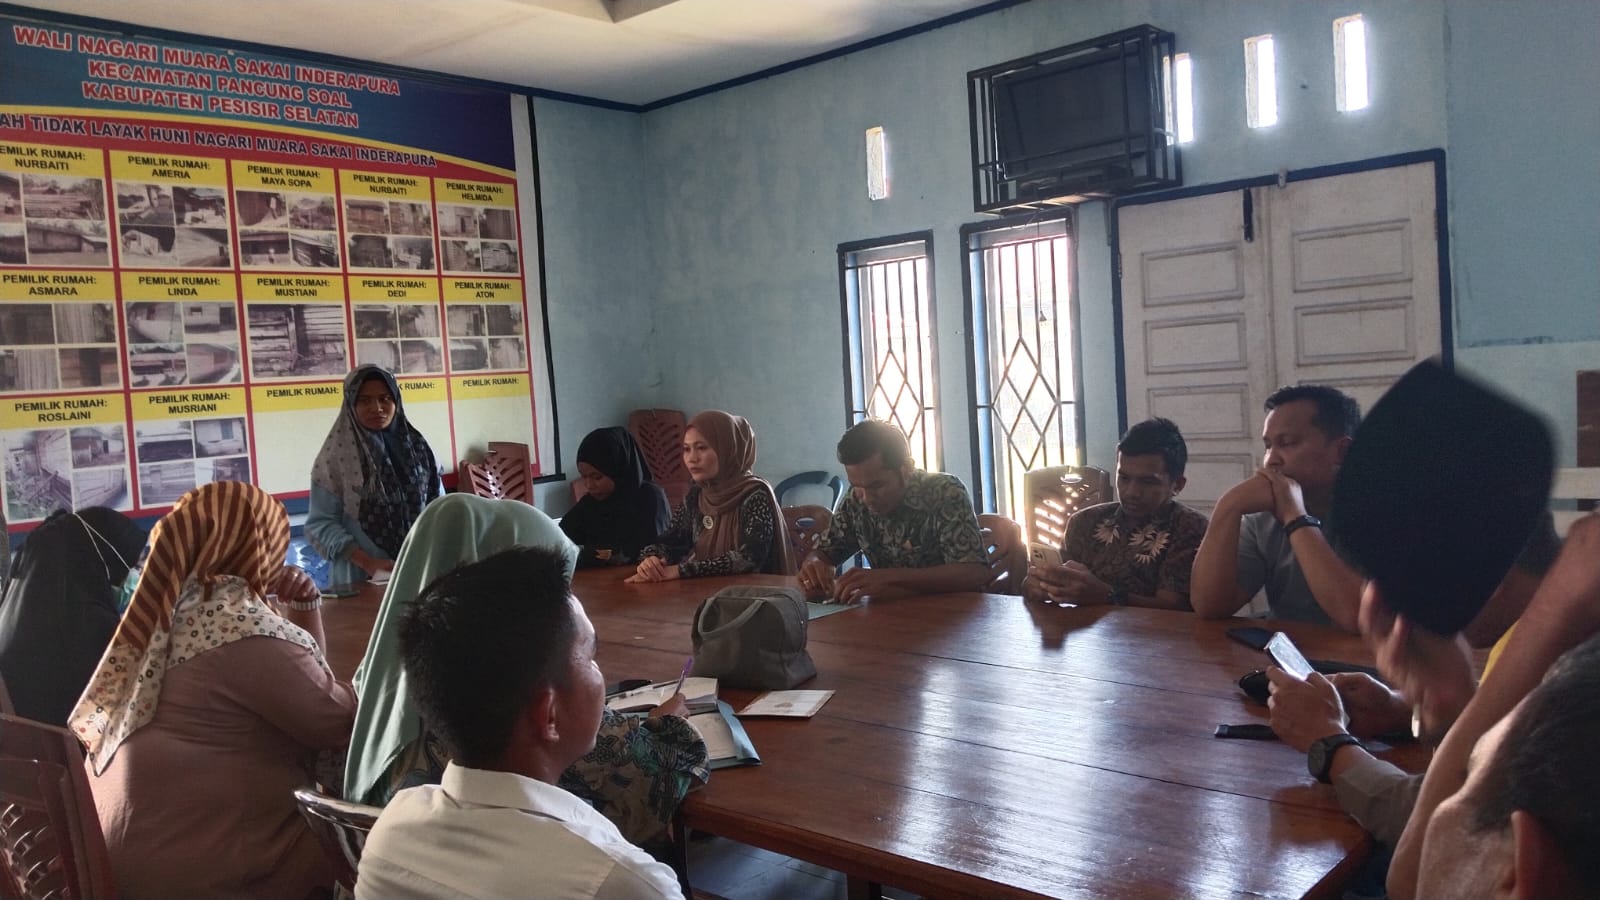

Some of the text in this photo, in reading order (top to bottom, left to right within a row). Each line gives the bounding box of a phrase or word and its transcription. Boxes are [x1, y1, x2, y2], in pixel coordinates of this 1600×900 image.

[13, 25, 400, 96] WALI NAGARI MUARA SAKAI INDERAPURA
[88, 59, 352, 109] KECAMATAN PANCUNG SOAL
[82, 81, 358, 128] KABUPATEN PESISIR SELATAN
[30, 115, 86, 135] TIDAK
[90, 122, 145, 141] LAYAK
[150, 128, 190, 145] HUNI
[194, 133, 252, 150] NAGARI
[256, 138, 308, 155] MUARA
[311, 142, 352, 160] SAKAI
[356, 147, 437, 167] INDERAPURA
[41, 148, 86, 161] RUMAH:
[15, 158, 70, 171] NURBAITI
[128, 155, 210, 170] PEMILIK RUMAH:
[151, 168, 191, 179] AMERIA
[247, 165, 320, 178] PEMILIK RUMAH:
[261, 177, 312, 188] MAYA SOPA
[353, 174, 418, 187] PEMILIK RUMAH:
[370, 185, 407, 196] NURBAITI
[446, 182, 504, 194] PEMILIK RUMAH:
[461, 192, 493, 203] HELMIDA
[3, 274, 97, 285] PEMILIK RUMAH:
[138, 276, 220, 286] PEMILIK RUMAH:
[257, 278, 330, 288] PEMILIK RUMAH:
[362, 280, 427, 289] PEMILIK RUMAH:
[454, 281, 511, 290] PEMILIK RUMAH:
[28, 286, 78, 297] ASMARA
[167, 287, 198, 297] LINDA
[275, 288, 317, 298] MUSTIANI
[388, 289, 406, 298] DEDI
[476, 290, 495, 299] ATON
[405, 382, 434, 390] RUMAH:
[462, 379, 491, 387] PEMILIK
[149, 392, 231, 404] PEMILIK RUMAH:
[266, 387, 339, 398] PEMILIK RUMAH:
[15, 399, 107, 412] PEMILIK RUMAH:
[168, 404, 217, 414] MUSRIANI
[38, 411, 91, 422] ROSLAINI
